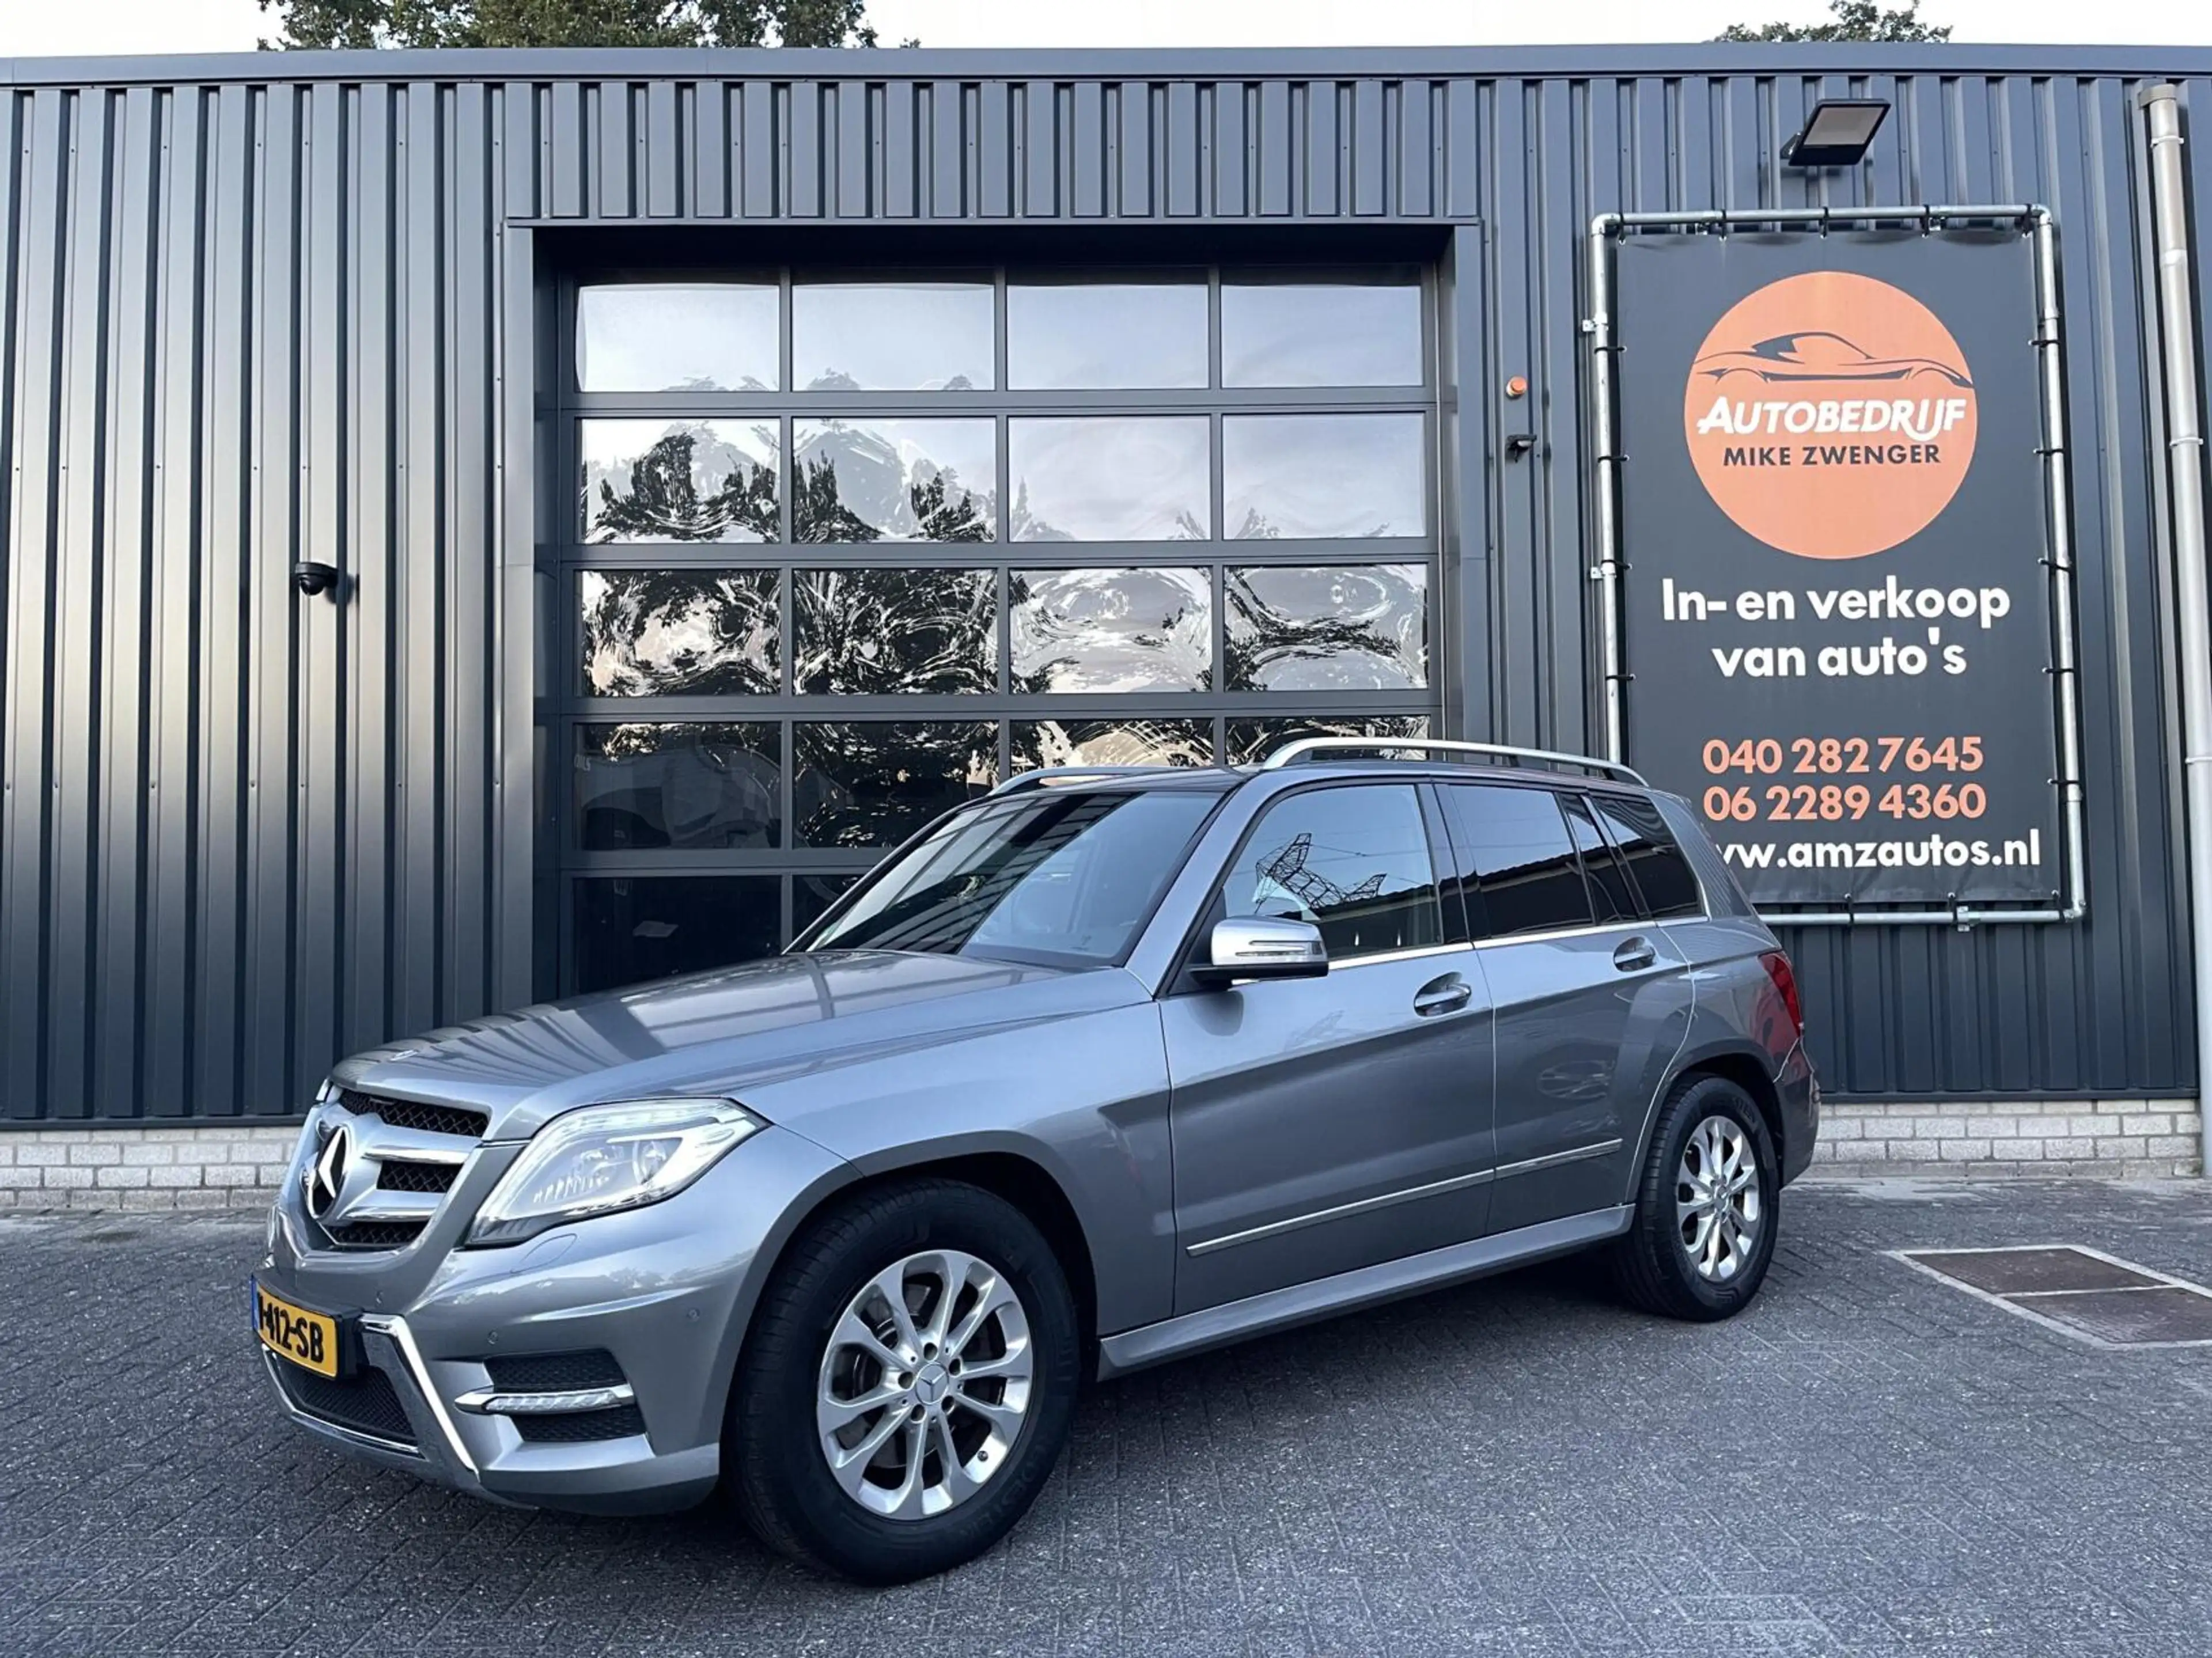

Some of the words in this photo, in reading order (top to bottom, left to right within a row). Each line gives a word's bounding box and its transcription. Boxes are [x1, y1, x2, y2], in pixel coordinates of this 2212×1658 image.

[1697, 396, 1967, 441] AUTOBEDRIJF
[1723, 446, 1791, 466] MIKE
[1802, 444, 1941, 465] ZWENGER
[1662, 578, 1727, 620] In-
[1736, 590, 1795, 620] en
[1806, 575, 2010, 628] verkoop
[1711, 647, 1806, 677] van
[1817, 627, 1967, 676] auto's
[1702, 739, 1783, 774] 040
[1791, 738, 1870, 773] 282
[1877, 736, 1984, 772] 7645
[1703, 786, 1757, 821] 06
[1767, 785, 1870, 821] 2289
[1878, 784, 1987, 819] 4360
